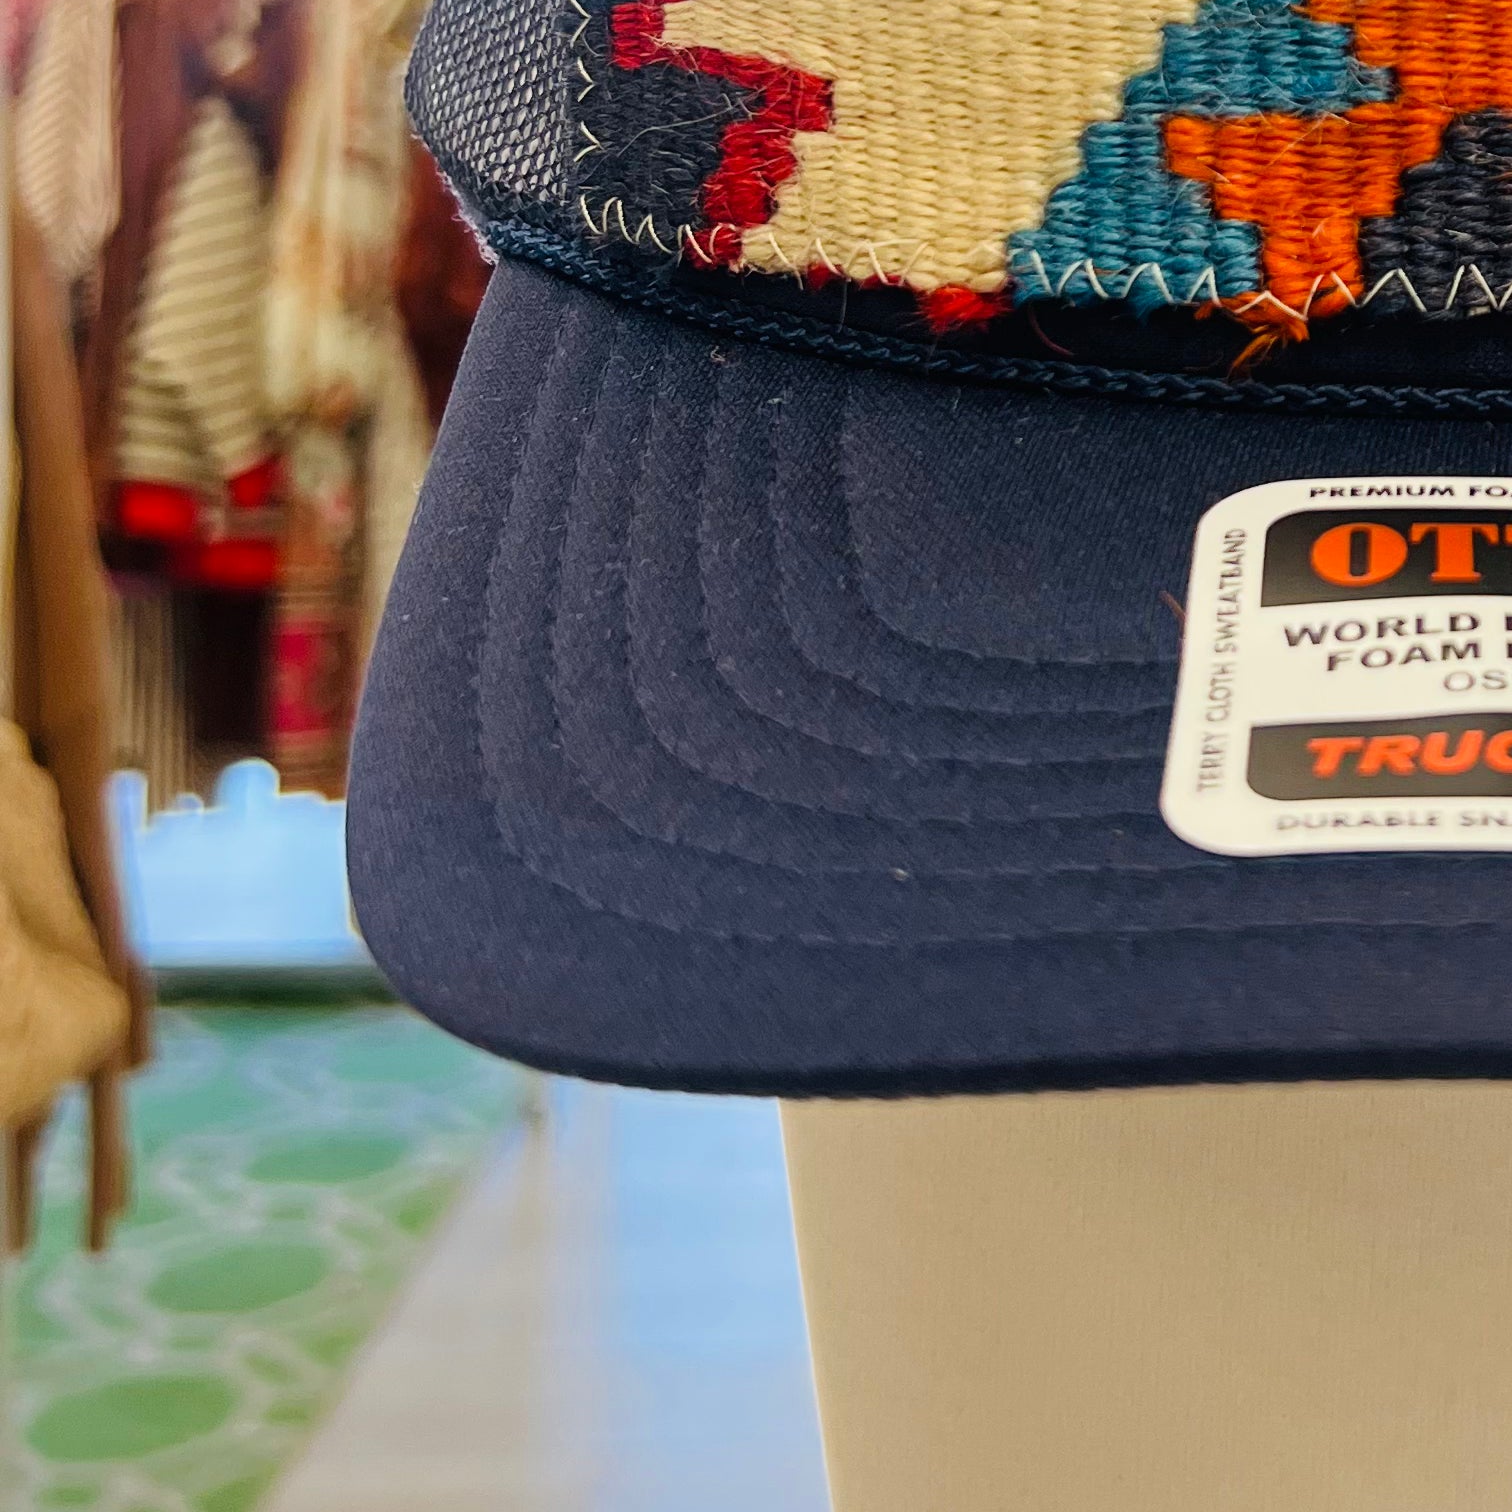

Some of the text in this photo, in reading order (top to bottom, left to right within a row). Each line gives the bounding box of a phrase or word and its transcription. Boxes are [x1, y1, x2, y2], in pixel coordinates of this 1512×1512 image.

[1309, 485, 1456, 499] PREMIUM
[1214, 528, 1247, 654] SWEATBAND
[1283, 612, 1481, 648] WORLD
[1326, 639, 1483, 672] FOAM
[1206, 661, 1237, 724] CLOTH
[1276, 809, 1440, 831] DURABLE
